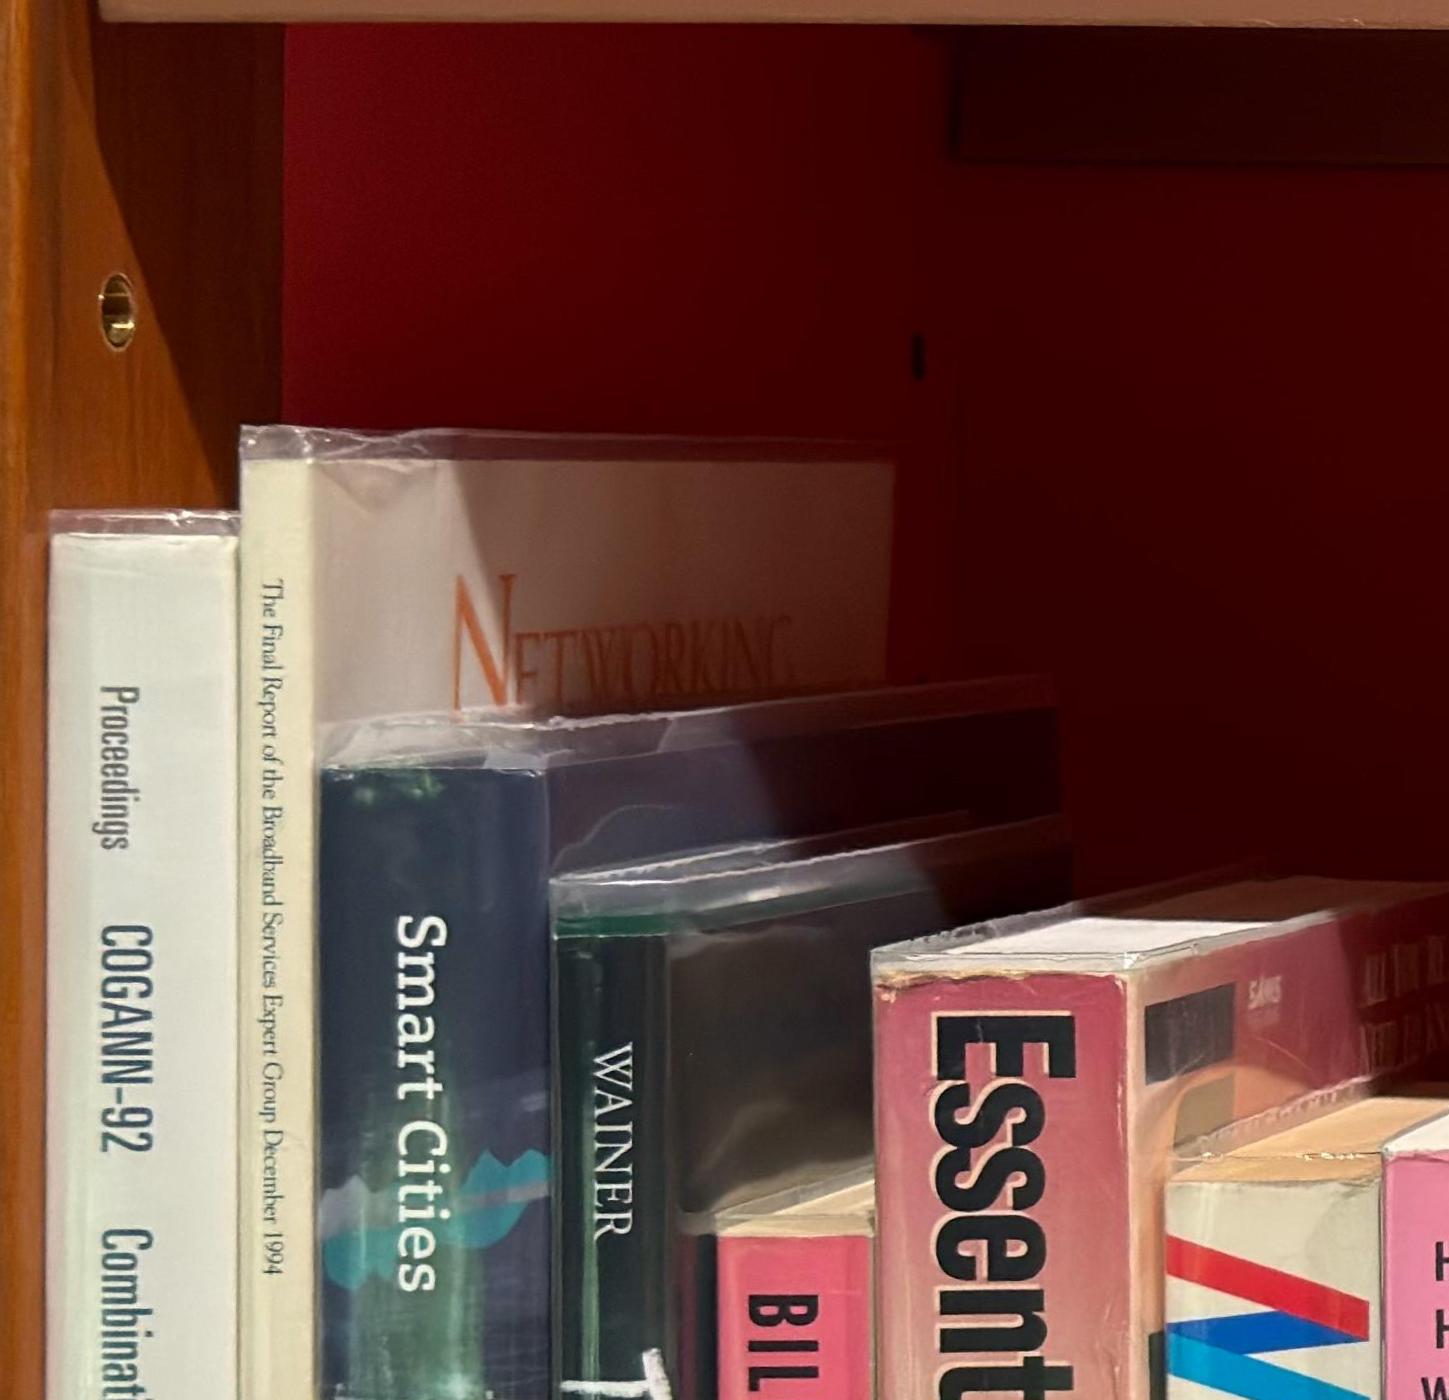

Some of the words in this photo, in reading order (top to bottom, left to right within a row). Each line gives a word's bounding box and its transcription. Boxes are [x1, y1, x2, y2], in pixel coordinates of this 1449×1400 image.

[262, 579, 284, 617] The
[262, 624, 283, 669] Final
[257, 677, 283, 737] Report
[92, 687, 140, 850] Proceedings
[262, 770, 283, 799] the
[263, 745, 283, 764] of
[262, 807, 284, 905] Broadband
[262, 913, 283, 988] Services
[101, 925, 153, 1152] COGANN-92
[257, 995, 283, 1055] Expert
[397, 916, 446, 1099] Smart
[259, 1062, 283, 1123] Group
[592, 1042, 634, 1241] WAINER
[263, 1130, 284, 1224] December
[397, 1121, 447, 1292] Cities
[263, 1234, 283, 1275] 1994
